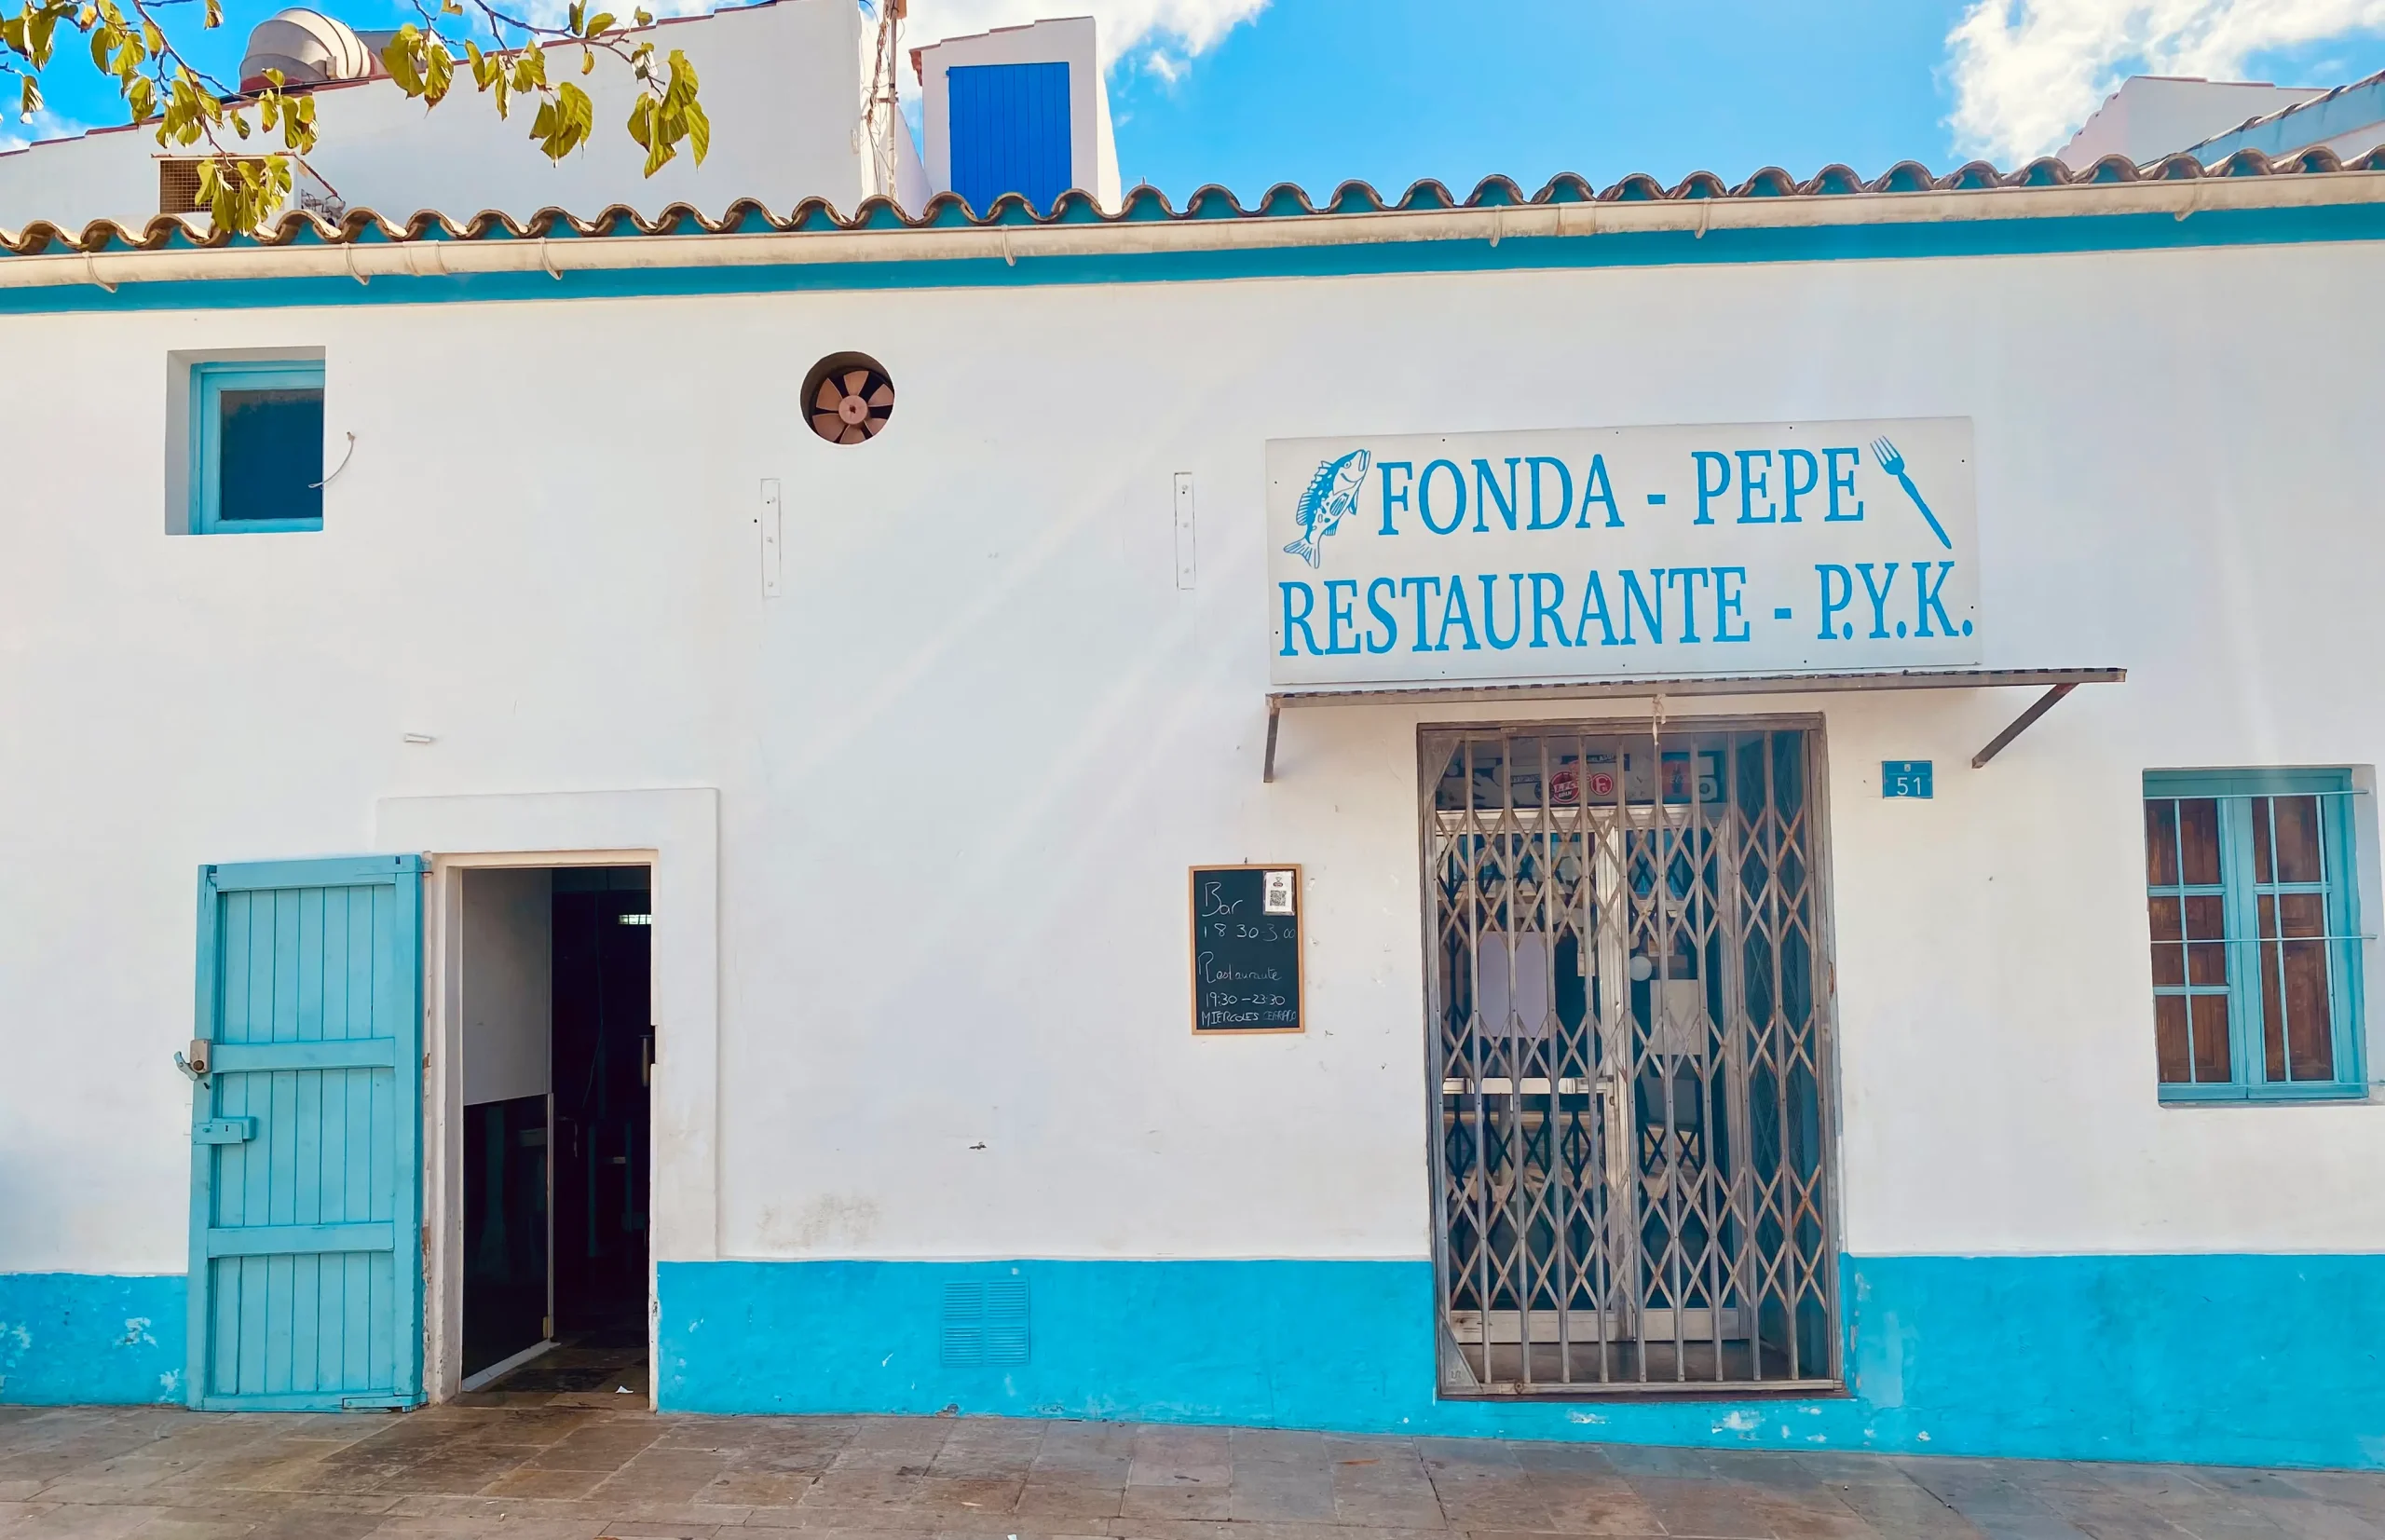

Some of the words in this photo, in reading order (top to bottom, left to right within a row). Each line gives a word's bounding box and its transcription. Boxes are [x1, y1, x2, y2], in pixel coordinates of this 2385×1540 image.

[1375, 454, 1624, 536] FONDA
[1691, 447, 1864, 525] PEPE
[1278, 566, 1751, 656] RESTAURANTE
[1815, 561, 1973, 641] P.Y.K.
[1896, 776, 1921, 796] 51
[1202, 881, 1244, 917] Bar
